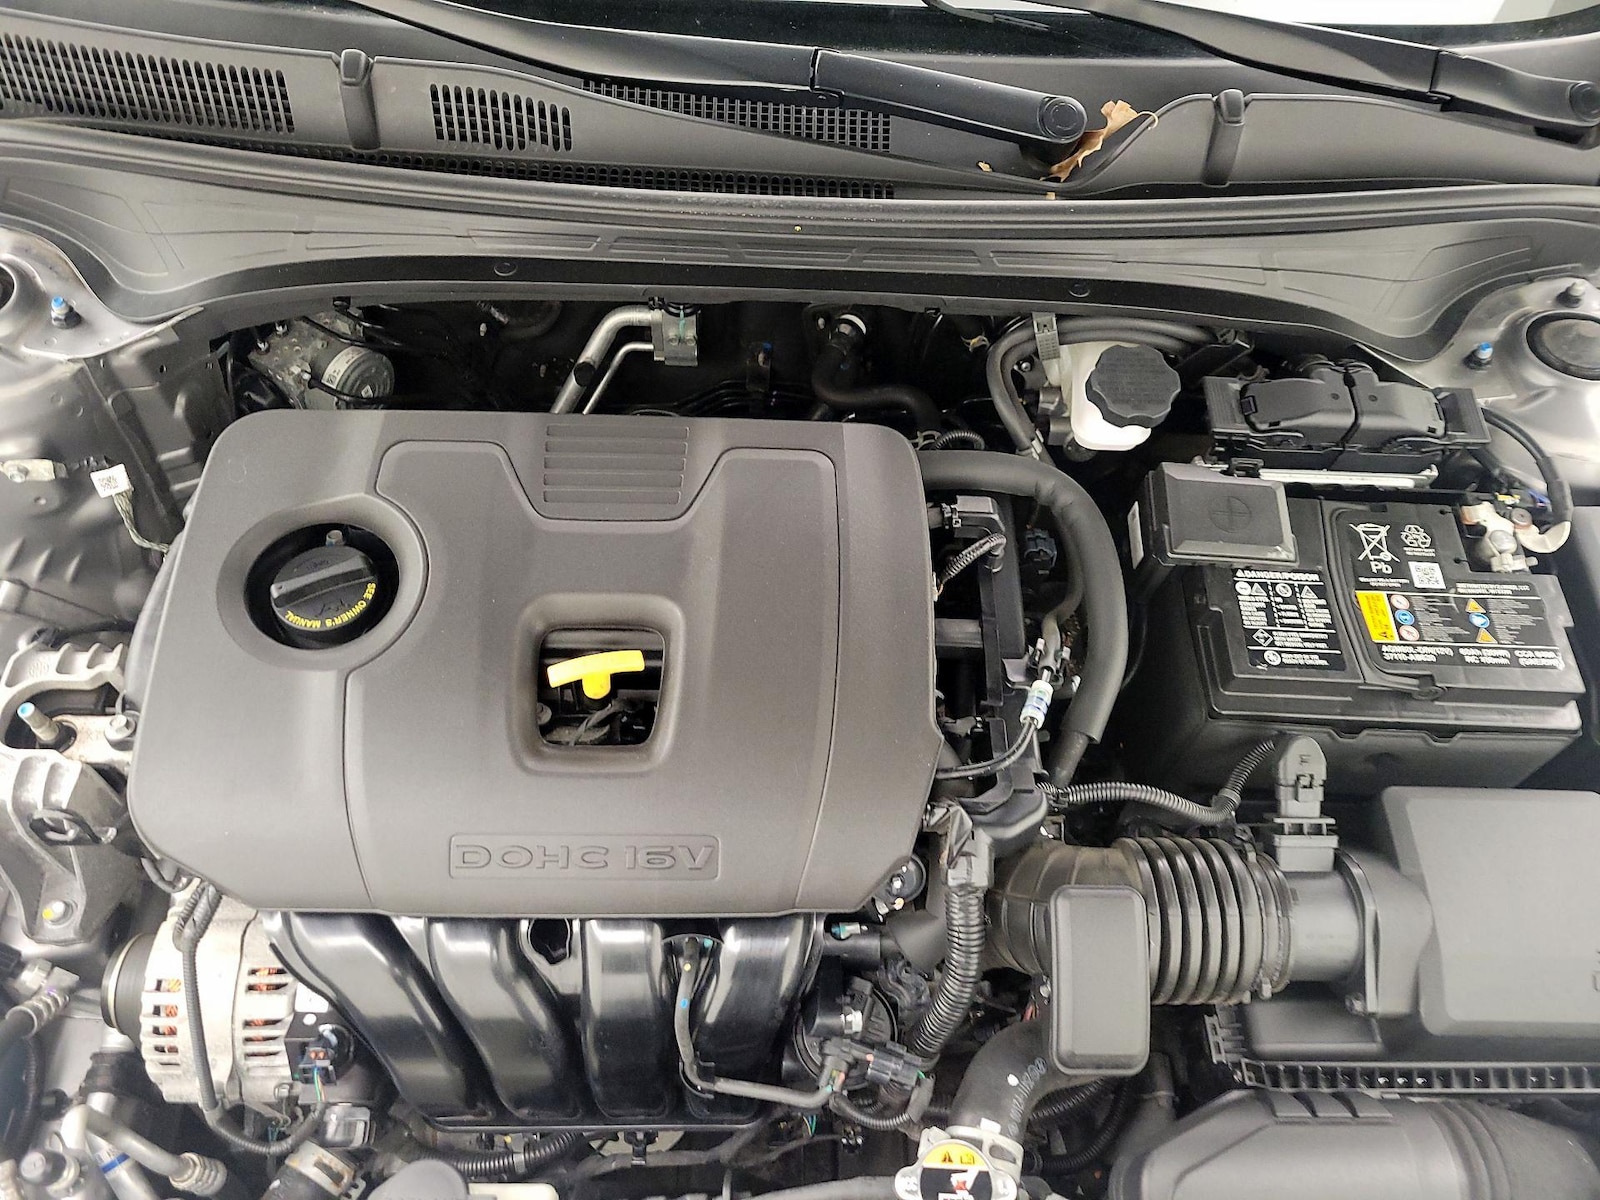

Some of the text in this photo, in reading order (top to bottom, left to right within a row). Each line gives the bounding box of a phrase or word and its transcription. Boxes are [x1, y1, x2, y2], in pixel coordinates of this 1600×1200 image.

[1244, 570, 1320, 582] DANGER/POISON
[1371, 561, 1392, 574] Pb
[285, 583, 376, 628] SEE OWNER'S MANUAL
[454, 845, 714, 870] DOHC 16V
